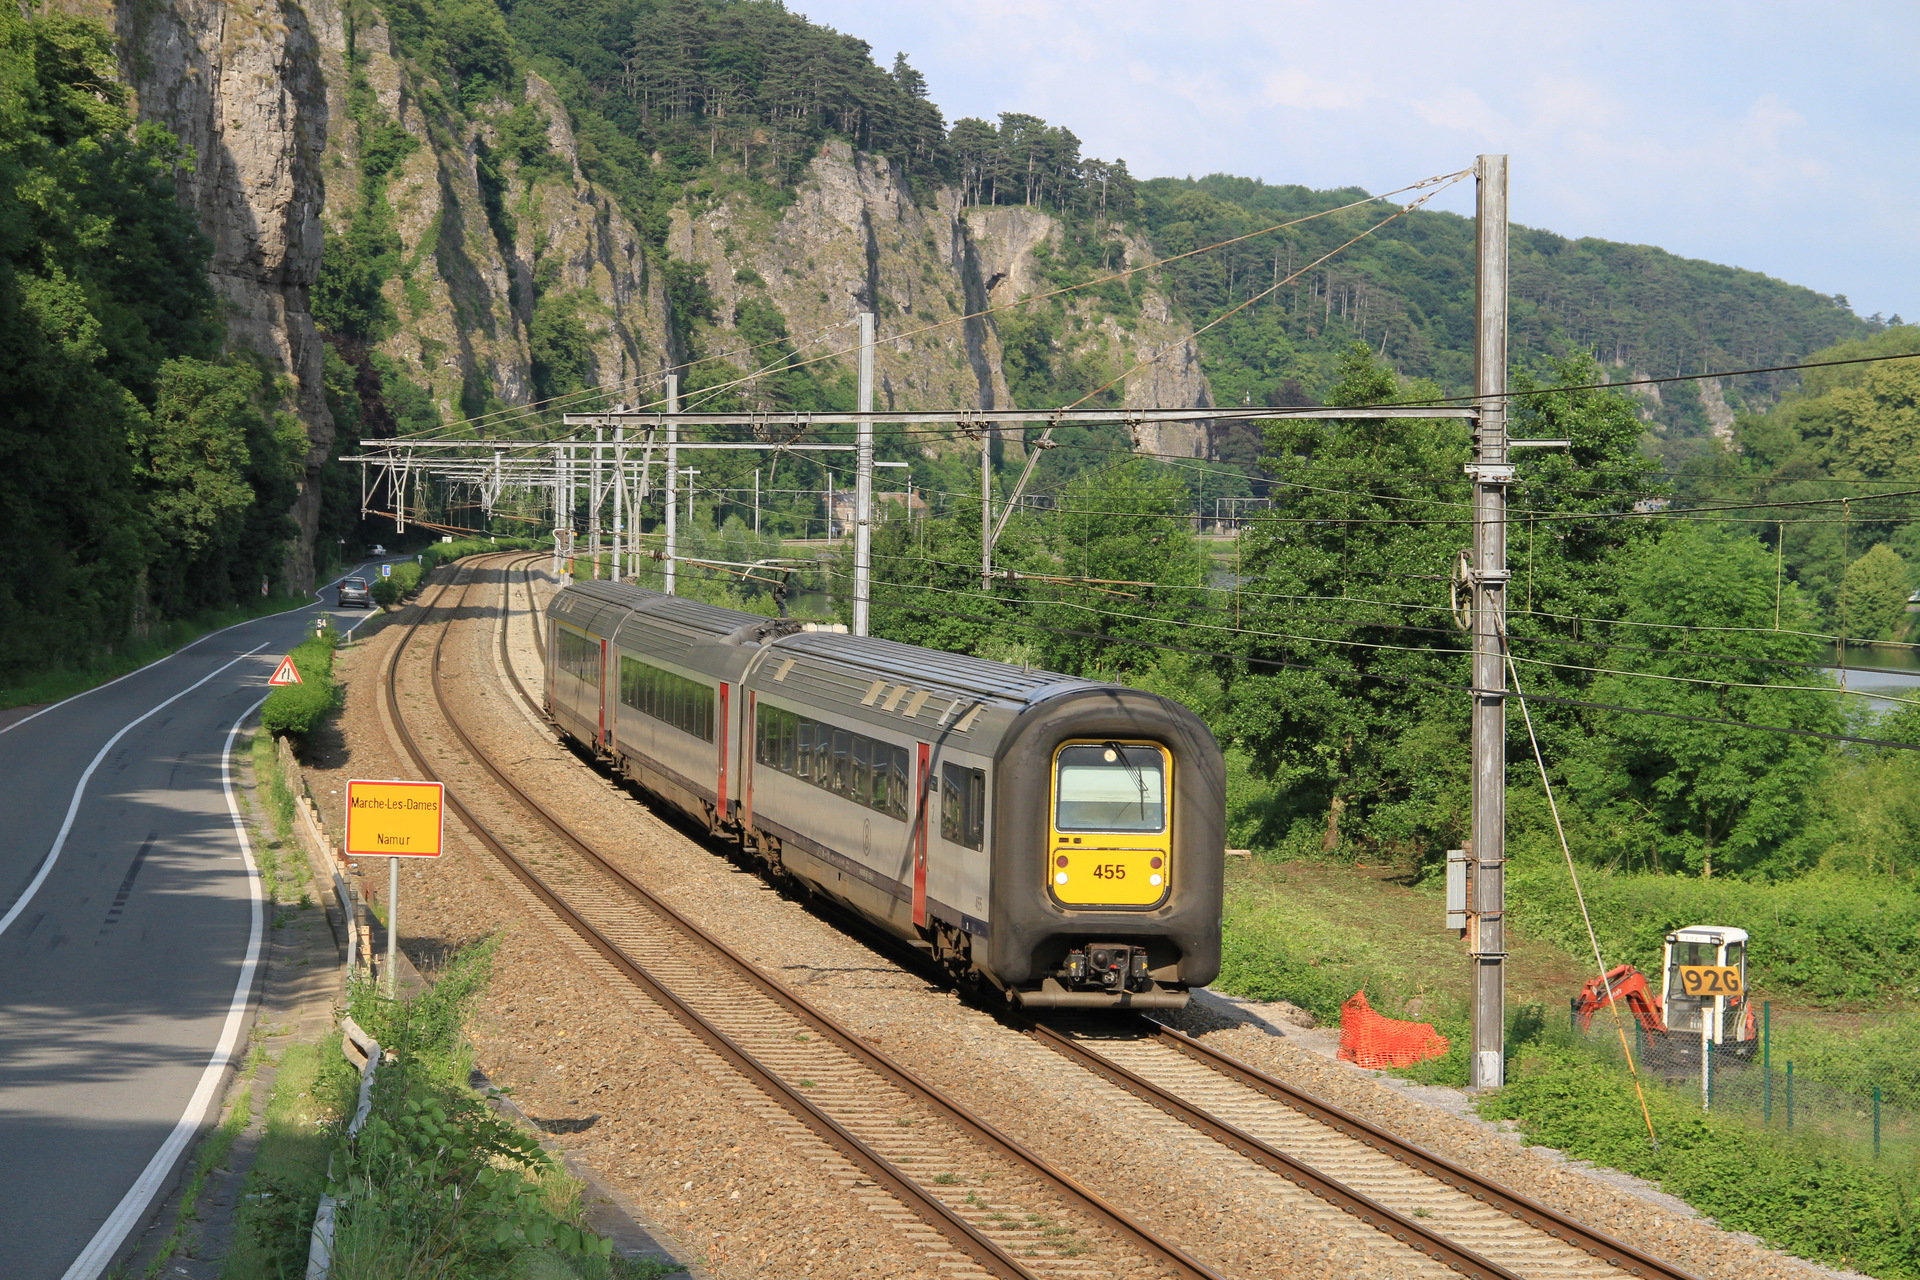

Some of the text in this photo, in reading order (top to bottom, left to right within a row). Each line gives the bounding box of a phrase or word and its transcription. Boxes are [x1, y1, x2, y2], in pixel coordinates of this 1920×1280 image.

[351, 796, 438, 811] Marche-Les-Dames
[377, 833, 411, 846] Namur
[1093, 864, 1126, 880] 455
[1685, 969, 1739, 992] 92G
